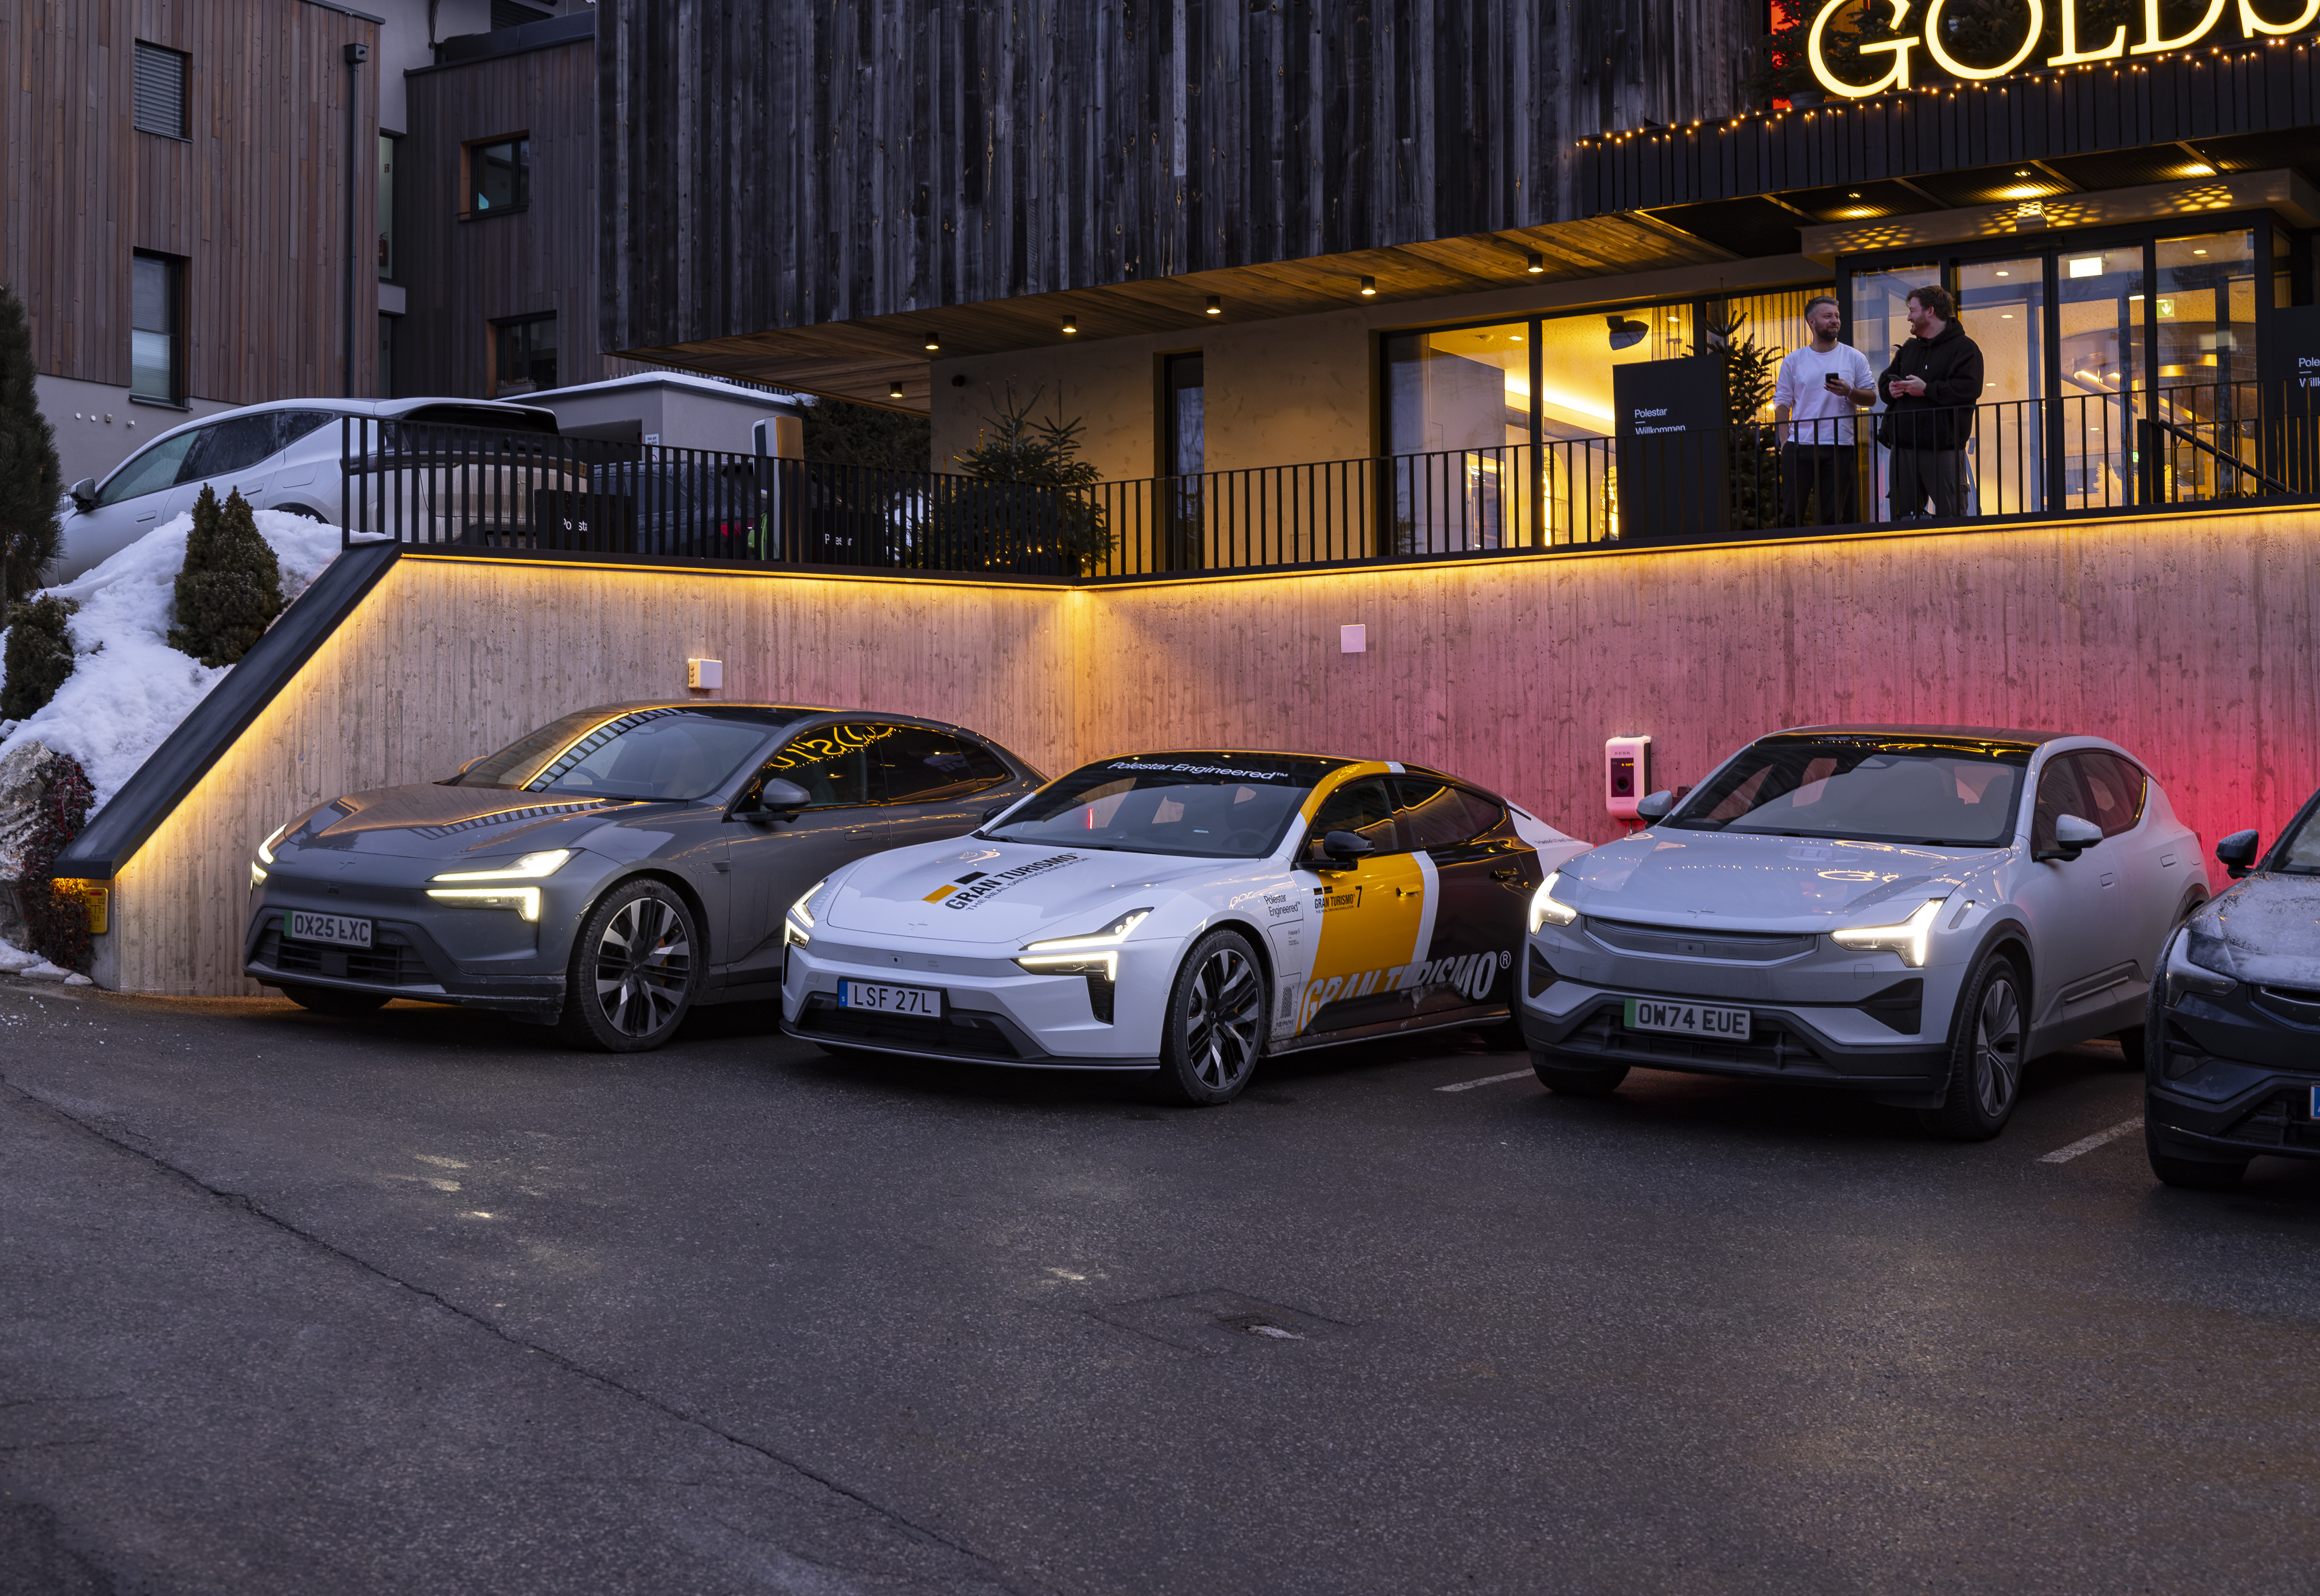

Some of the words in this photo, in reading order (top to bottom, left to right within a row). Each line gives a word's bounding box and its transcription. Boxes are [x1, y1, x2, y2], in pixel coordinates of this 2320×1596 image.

[1635, 408, 1668, 418] Polestar
[1635, 425, 1686, 435] Willkommen
[945, 879, 1003, 910] GRAN
[966, 899, 987, 910] THE
[984, 887, 1009, 899] REAL
[1007, 872, 1043, 885] DRIVING
[1263, 895, 1286, 905] Polestar
[1315, 897, 1329, 909] GRAN
[1355, 885, 1362, 908] 7
[295, 915, 334, 937] OX25
[339, 919, 368, 942] LXC
[855, 985, 888, 1008] LSF
[896, 990, 931, 1013] 27L
[1639, 1003, 1695, 1029] OW74
[1703, 1009, 1746, 1034] EUE
